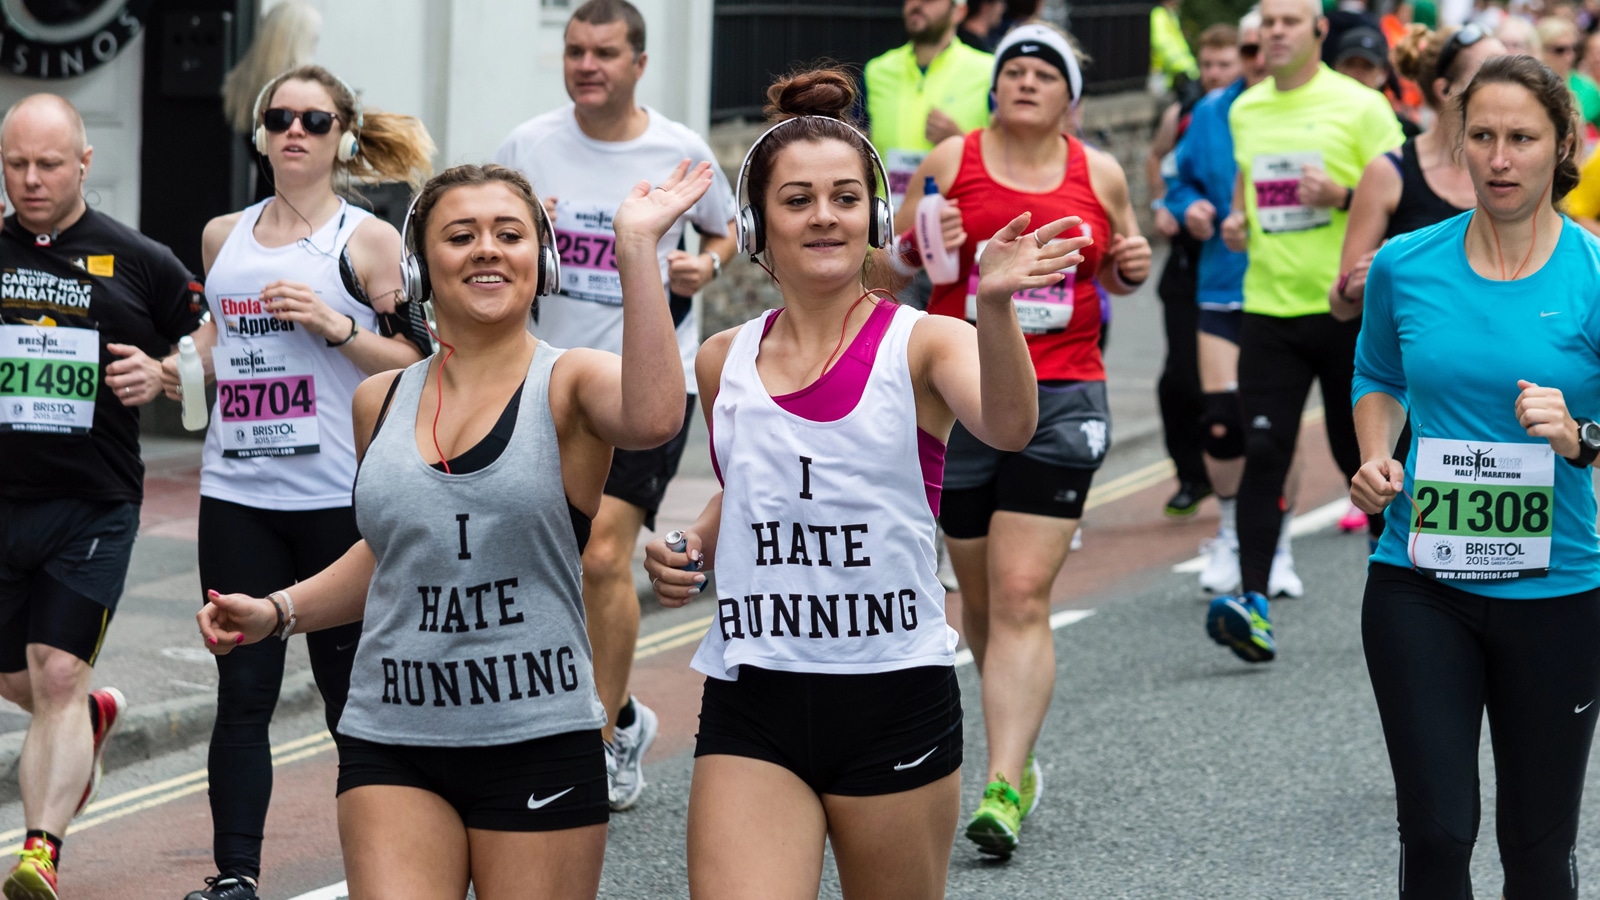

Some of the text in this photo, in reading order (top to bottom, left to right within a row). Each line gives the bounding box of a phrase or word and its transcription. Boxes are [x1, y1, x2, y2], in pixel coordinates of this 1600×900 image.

[0, 11, 139, 78] SINOS
[2, 273, 92, 295] CARDIFF HALF
[2, 285, 91, 309] MARATHON
[221, 298, 262, 316] Ebola
[239, 316, 295, 336] Appeal
[0, 362, 95, 398] 21498
[33, 401, 76, 415] BRISTOL
[221, 380, 313, 418] 25704
[252, 423, 297, 437] BRISTOL
[800, 456, 813, 500] I
[1454, 469, 1521, 479] HALF MARATHON
[1414, 486, 1549, 533] 21308
[456, 513, 472, 560] I
[752, 521, 871, 568] HATE
[1465, 542, 1526, 557] BRISTOL
[1435, 571, 1520, 580] www.runbristol.com
[1465, 556, 1490, 566] 2015
[417, 577, 525, 634] HATE
[718, 588, 919, 641] RUNNING
[381, 646, 579, 707] RUNNING
